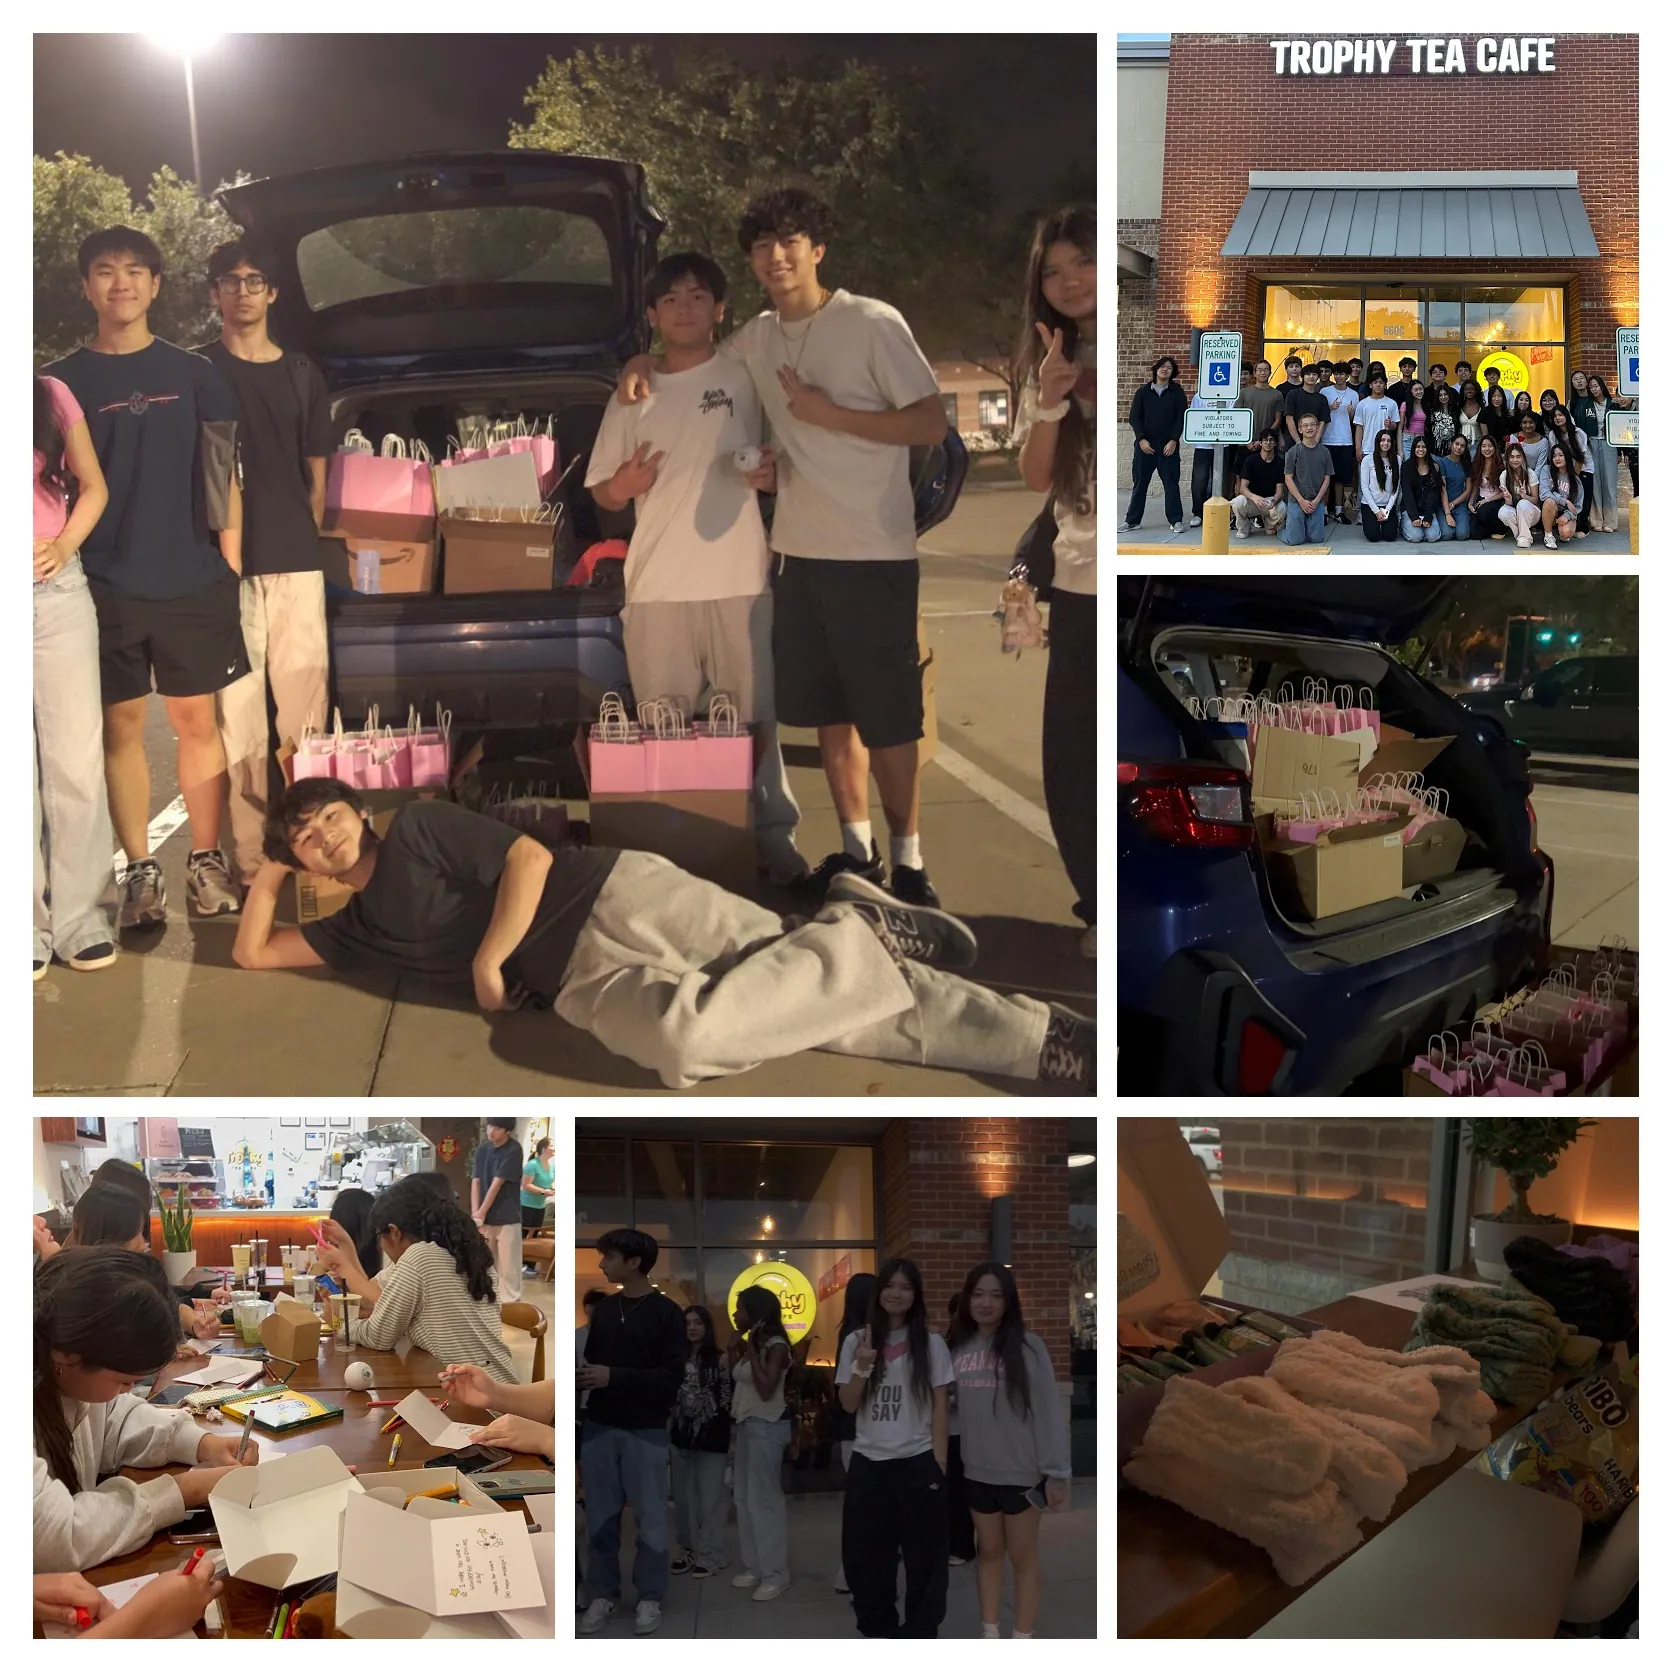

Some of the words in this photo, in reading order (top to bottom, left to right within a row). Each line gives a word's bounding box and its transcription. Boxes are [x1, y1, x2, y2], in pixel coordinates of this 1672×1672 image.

[1269, 39, 1397, 74] TROPHY
[1405, 38, 1466, 73] TEA
[1476, 37, 1556, 72] CAFE
[1203, 339, 1239, 348] RESERVED
[1205, 351, 1236, 360] PARKING
[875, 1384, 903, 1403] YOU
[871, 1403, 902, 1422] SAY
[1603, 1457, 1638, 1499] HARIB
